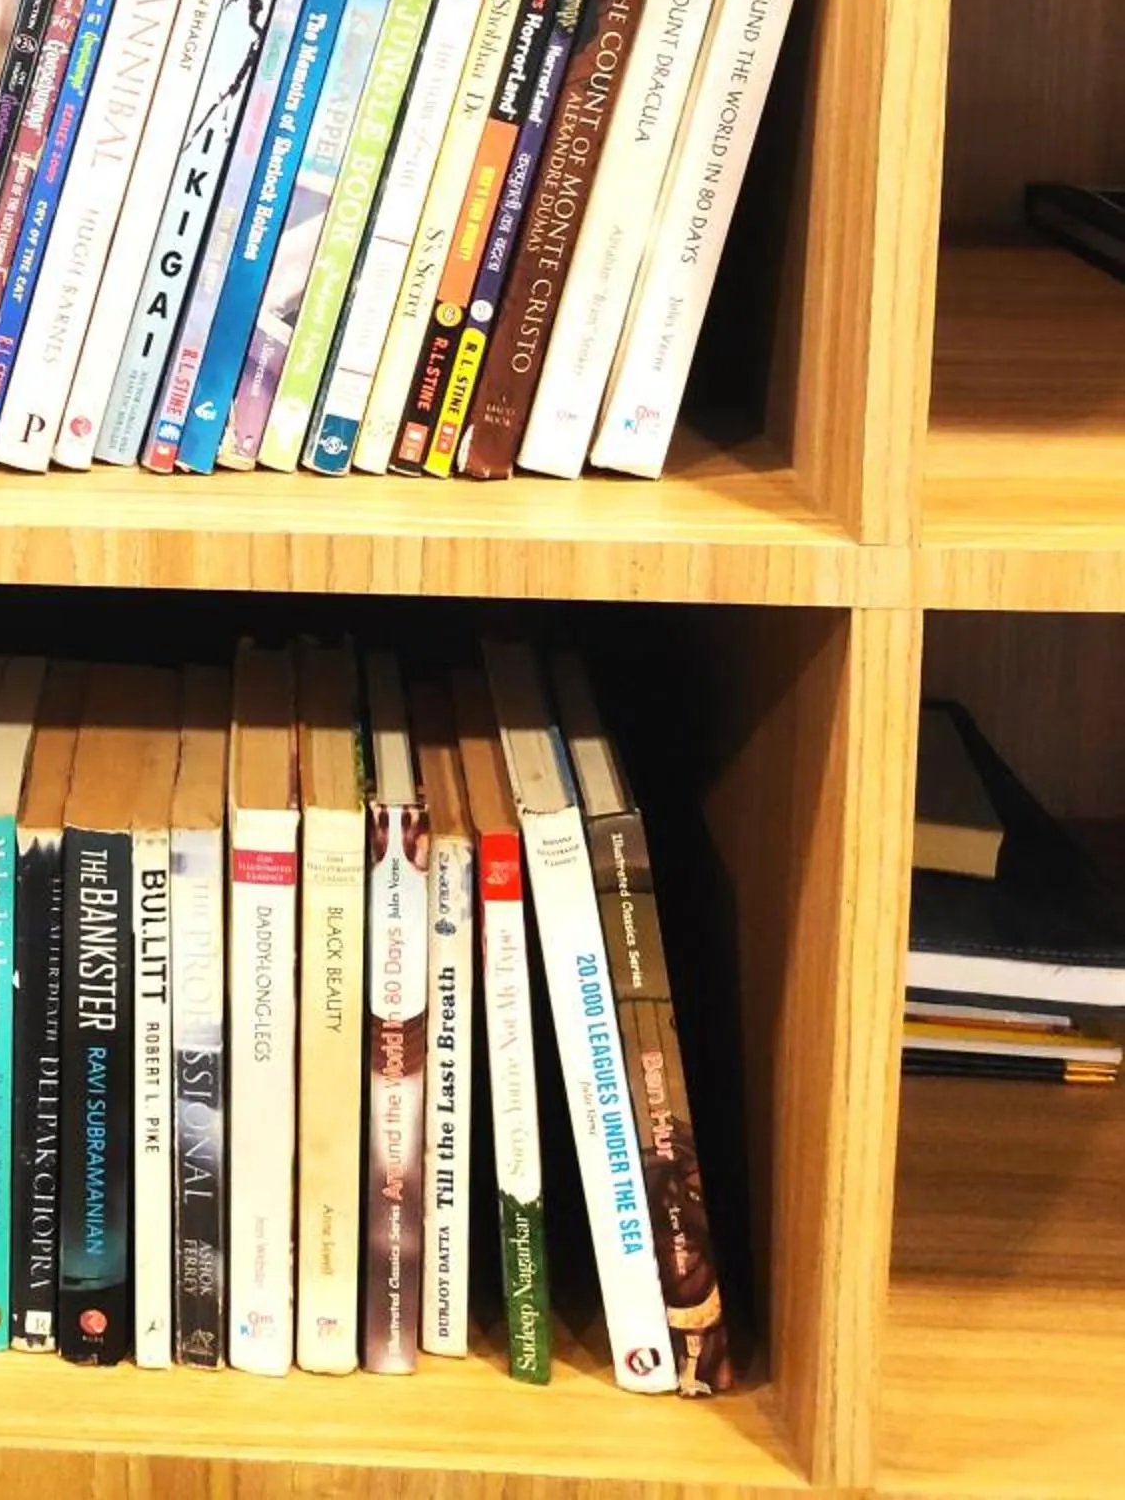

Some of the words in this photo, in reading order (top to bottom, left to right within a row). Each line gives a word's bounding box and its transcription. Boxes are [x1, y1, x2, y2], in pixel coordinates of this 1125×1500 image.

[176, 8, 209, 74] BHAGAT
[301, 9, 328, 44] The
[20, 36, 71, 135] Goosebumps
[282, 42, 319, 114] Memoirs
[355, 0, 423, 144] JUNGLE
[577, 27, 623, 129] COUNT
[728, 46, 755, 86] THE
[277, 113, 298, 133] of
[631, 51, 675, 146] DRACULA
[708, 87, 744, 159] WORLD
[256, 133, 293, 205] Sherlock
[541, 89, 584, 191] ALEXANDRE
[565, 132, 593, 168] OF
[326, 149, 378, 246] BOOK
[692, 186, 716, 214] 80
[701, 160, 723, 185] IN
[30, 198, 49, 229] CRY
[240, 202, 274, 264] Holmes
[524, 191, 555, 254] DUMAS
[535, 170, 584, 273] MONTE
[678, 214, 708, 267] DAYS
[9, 275, 28, 303] CAT
[17, 246, 35, 274] THE
[506, 275, 554, 376] CRISTO
[19, 411, 48, 448] P
[443, 383, 467, 424] STINE
[78, 849, 108, 886] THE
[386, 856, 402, 888] Verne
[609, 831, 634, 898] Illustrated
[325, 905, 343, 960] BLACK
[387, 890, 401, 919] Jules
[619, 899, 640, 948] Classics
[77, 887, 118, 1031] BANKSTER
[253, 904, 273, 1063] DADDY-LONG-LEGS
[571, 951, 606, 1018] 20,000
[626, 948, 645, 990] Series
[324, 967, 342, 1034] BEAUTY
[435, 964, 458, 1052] Breath
[86, 1046, 107, 1094] RAVI
[144, 1021, 160, 1085] ROBERT
[584, 1019, 619, 1107] LEAGUES
[638, 1049, 671, 1107] Ben
[436, 1059, 457, 1113] Last
[143, 1117, 160, 1154] PIKE
[437, 1121, 456, 1160] the
[599, 1109, 631, 1175] UNDER
[646, 1106, 679, 1163] Hur
[84, 1099, 106, 1255] SUBRAMANIAN
[436, 1167, 455, 1209] Till
[610, 1178, 638, 1214] THE
[28, 1172, 56, 1290] CHOPRA
[388, 1202, 402, 1240] Series
[438, 1224, 452, 1272] DATTA
[616, 1216, 644, 1256] SEA
[180, 1238, 198, 1296] FERREY
[197, 1238, 213, 1298] ASHOK
[386, 1242, 401, 1289] Classics
[507, 1210, 540, 1297] Nagarkar
[437, 1276, 453, 1337] DURJOY
[511, 1302, 544, 1372] Sudeep
